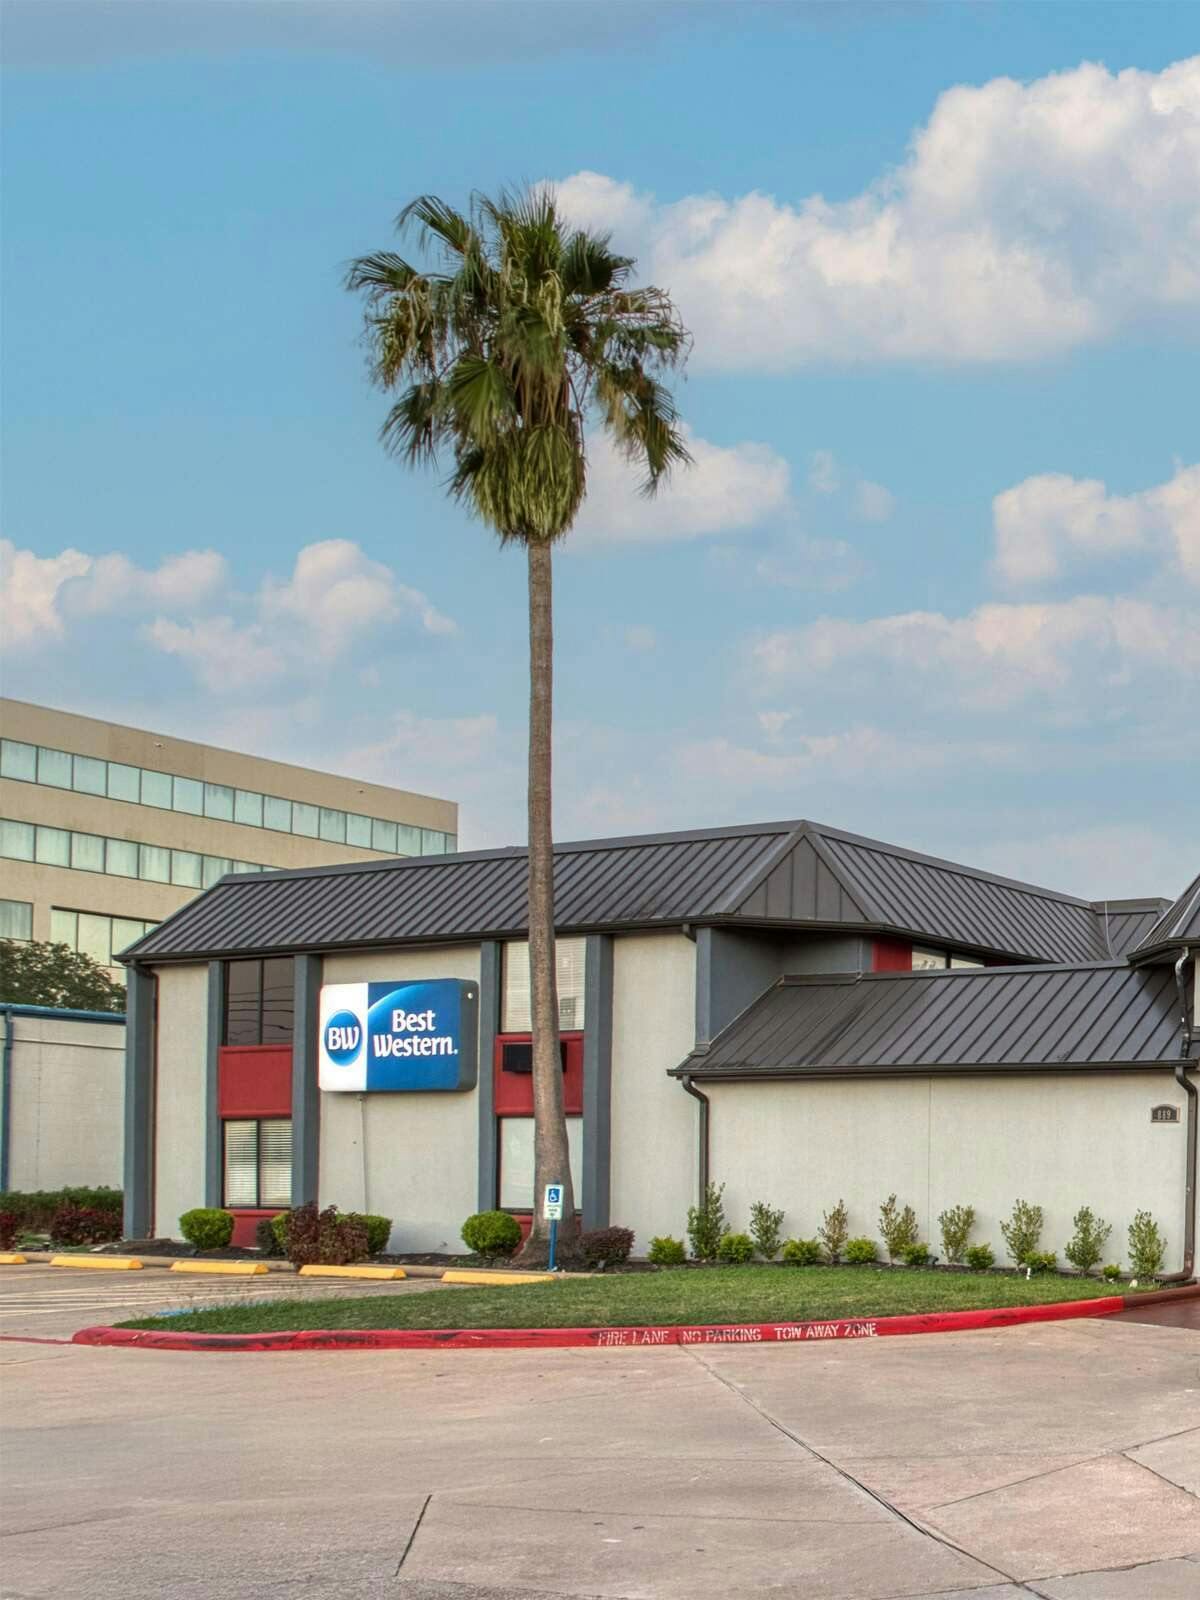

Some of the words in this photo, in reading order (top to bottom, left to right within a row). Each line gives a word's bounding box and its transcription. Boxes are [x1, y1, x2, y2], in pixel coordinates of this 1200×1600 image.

[392, 1009, 436, 1032] Best
[328, 1027, 360, 1050] BW
[598, 1330, 629, 1346] FIRE
[632, 1330, 669, 1345] LANE
[682, 1330, 702, 1344] NO
[706, 1328, 762, 1342] PARKING
[774, 1327, 802, 1340] TOW
[806, 1324, 840, 1338] AWAY
[844, 1322, 878, 1337] ZONE
